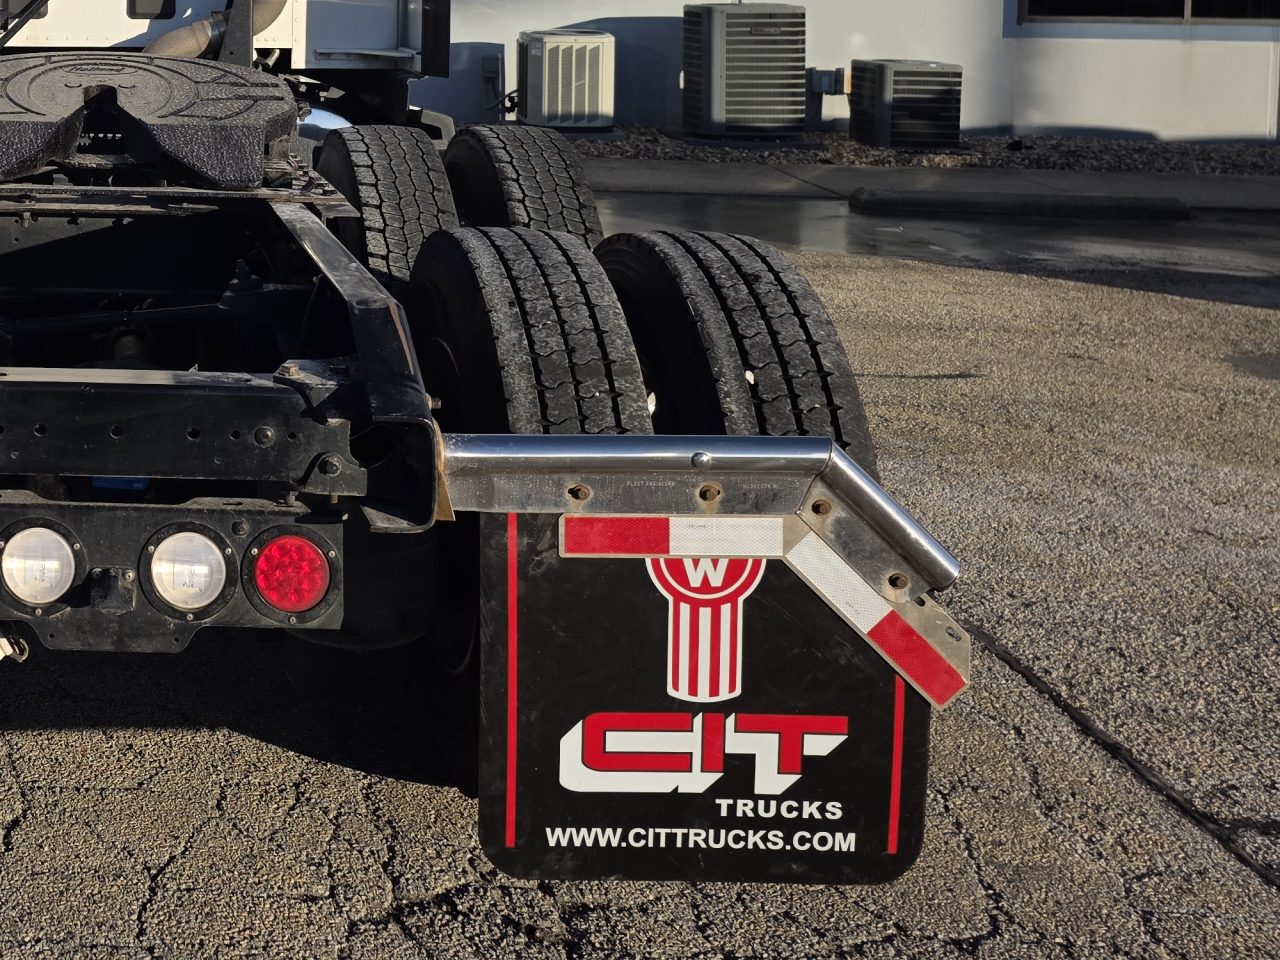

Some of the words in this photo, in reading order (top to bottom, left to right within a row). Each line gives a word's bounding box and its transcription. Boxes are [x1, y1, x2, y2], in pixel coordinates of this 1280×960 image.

[682, 558, 729, 588] W
[559, 712, 850, 795] CIT
[715, 798, 844, 821] TRUCKS
[545, 826, 857, 853] WWW.CITTRUCKS.COM
